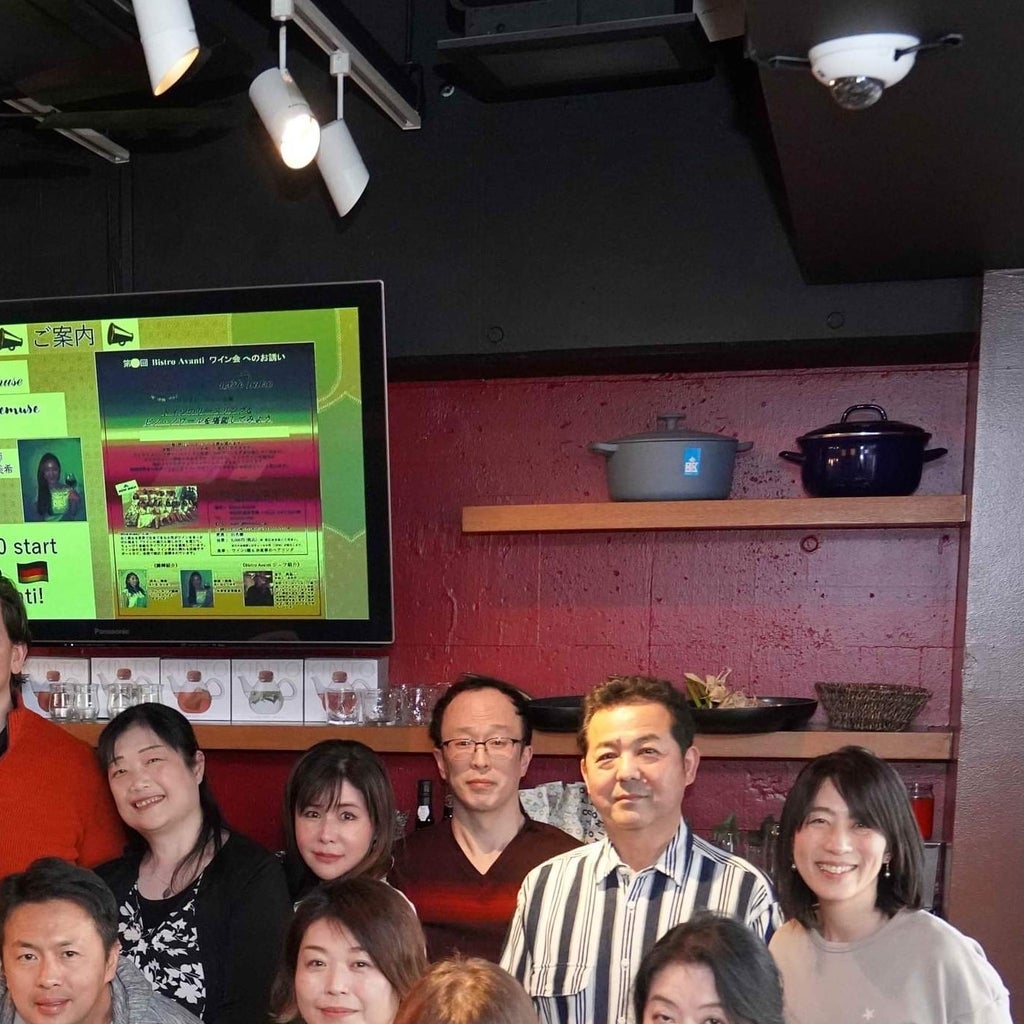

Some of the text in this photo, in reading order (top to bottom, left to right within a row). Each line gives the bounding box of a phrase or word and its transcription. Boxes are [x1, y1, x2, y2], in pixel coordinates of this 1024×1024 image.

[34, 324, 95, 347] ご案内
[152, 358, 176, 366] Bistro
[178, 356, 205, 365] Avanti
[13, 538, 58, 555] start
